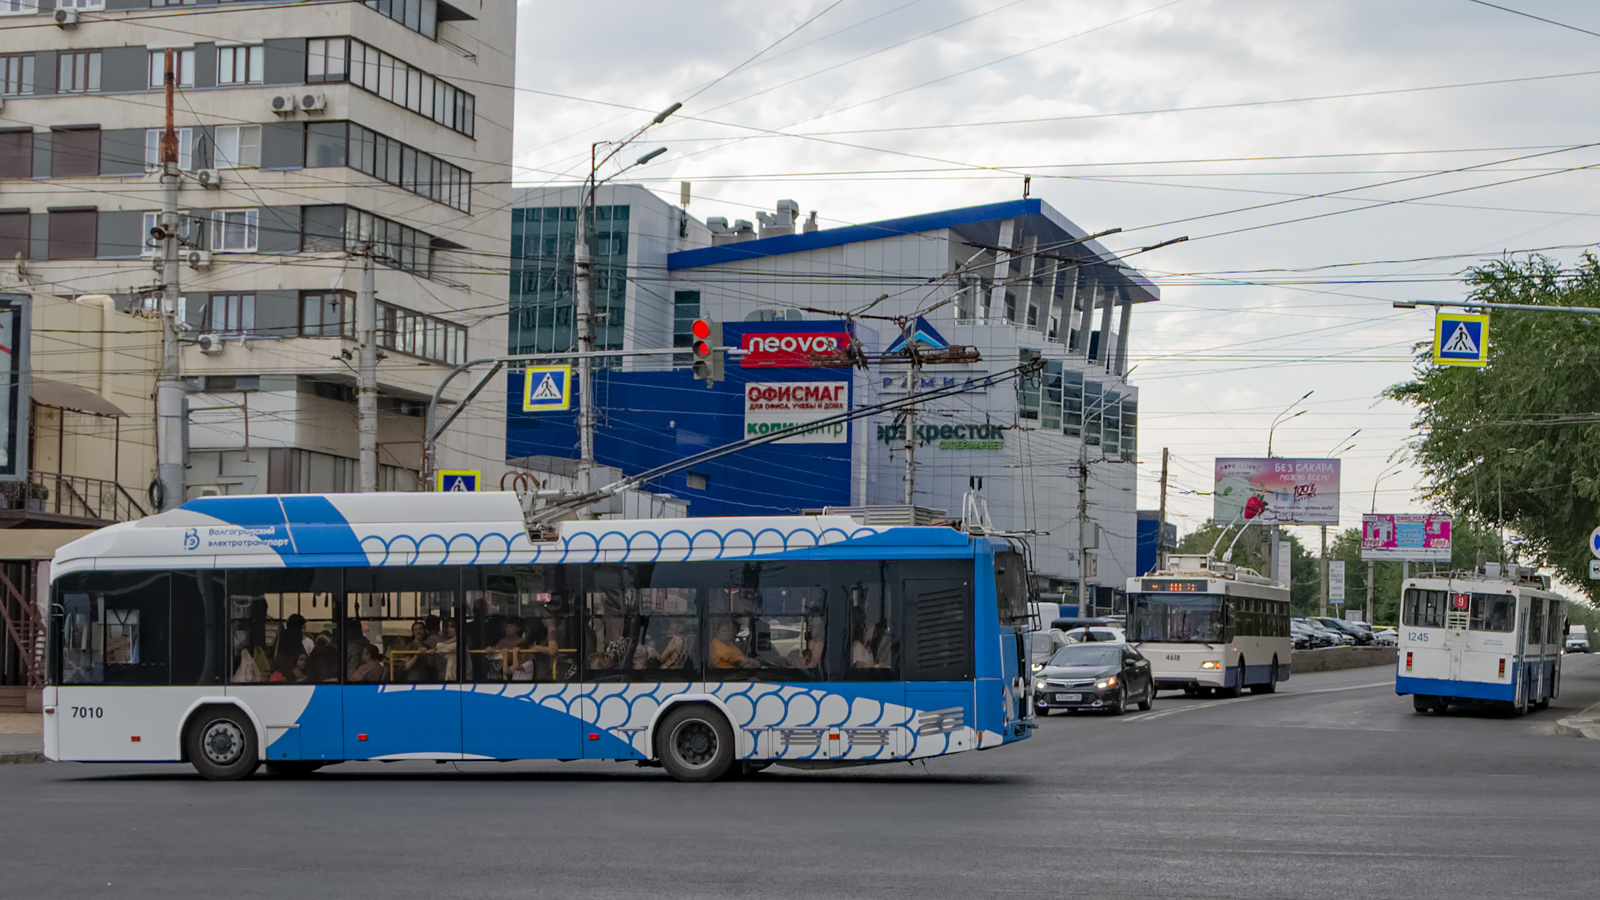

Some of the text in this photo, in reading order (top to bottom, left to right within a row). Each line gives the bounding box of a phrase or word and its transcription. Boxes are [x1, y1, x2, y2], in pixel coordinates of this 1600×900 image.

[748, 386, 845, 402] ОФИСМАГ
[1274, 463, 1293, 473] БЕЗ
[208, 526, 276, 537] Волгоградский
[208, 538, 289, 548] электротранспорт
[1459, 597, 1464, 606] 9
[1408, 631, 1429, 642] 1245
[71, 706, 104, 718] 7010
